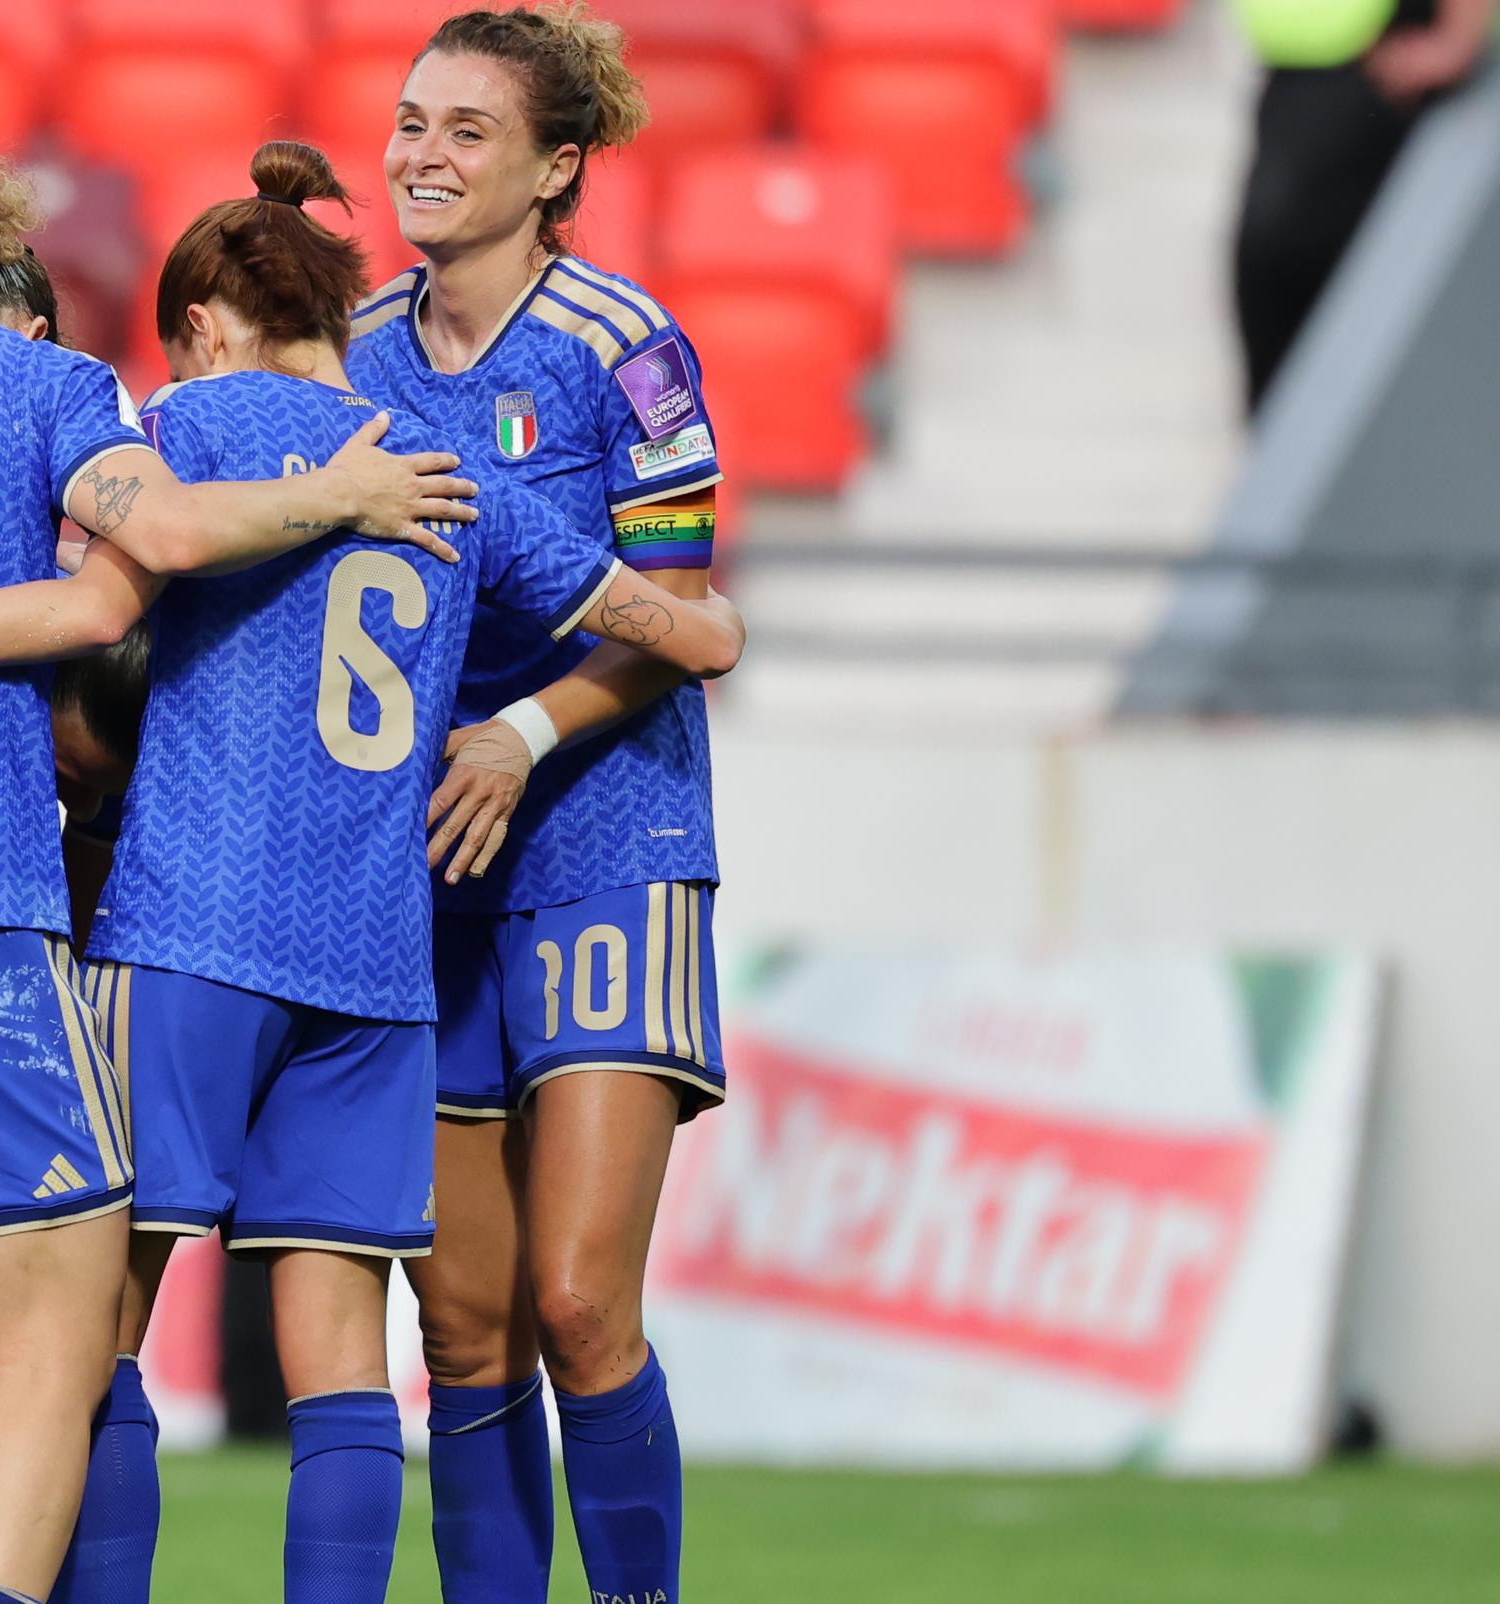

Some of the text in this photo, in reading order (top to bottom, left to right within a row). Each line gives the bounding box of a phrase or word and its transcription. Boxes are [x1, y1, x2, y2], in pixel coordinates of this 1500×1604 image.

[646, 388, 690, 418] EUROPEAN
[650, 399, 692, 427] QUALIFIERS
[634, 436, 711, 468] FOUNDATIO
[616, 520, 677, 541] ESPECT
[316, 550, 427, 772] 6
[536, 923, 628, 1041] 10
[688, 1076, 1222, 1348] Nektar
